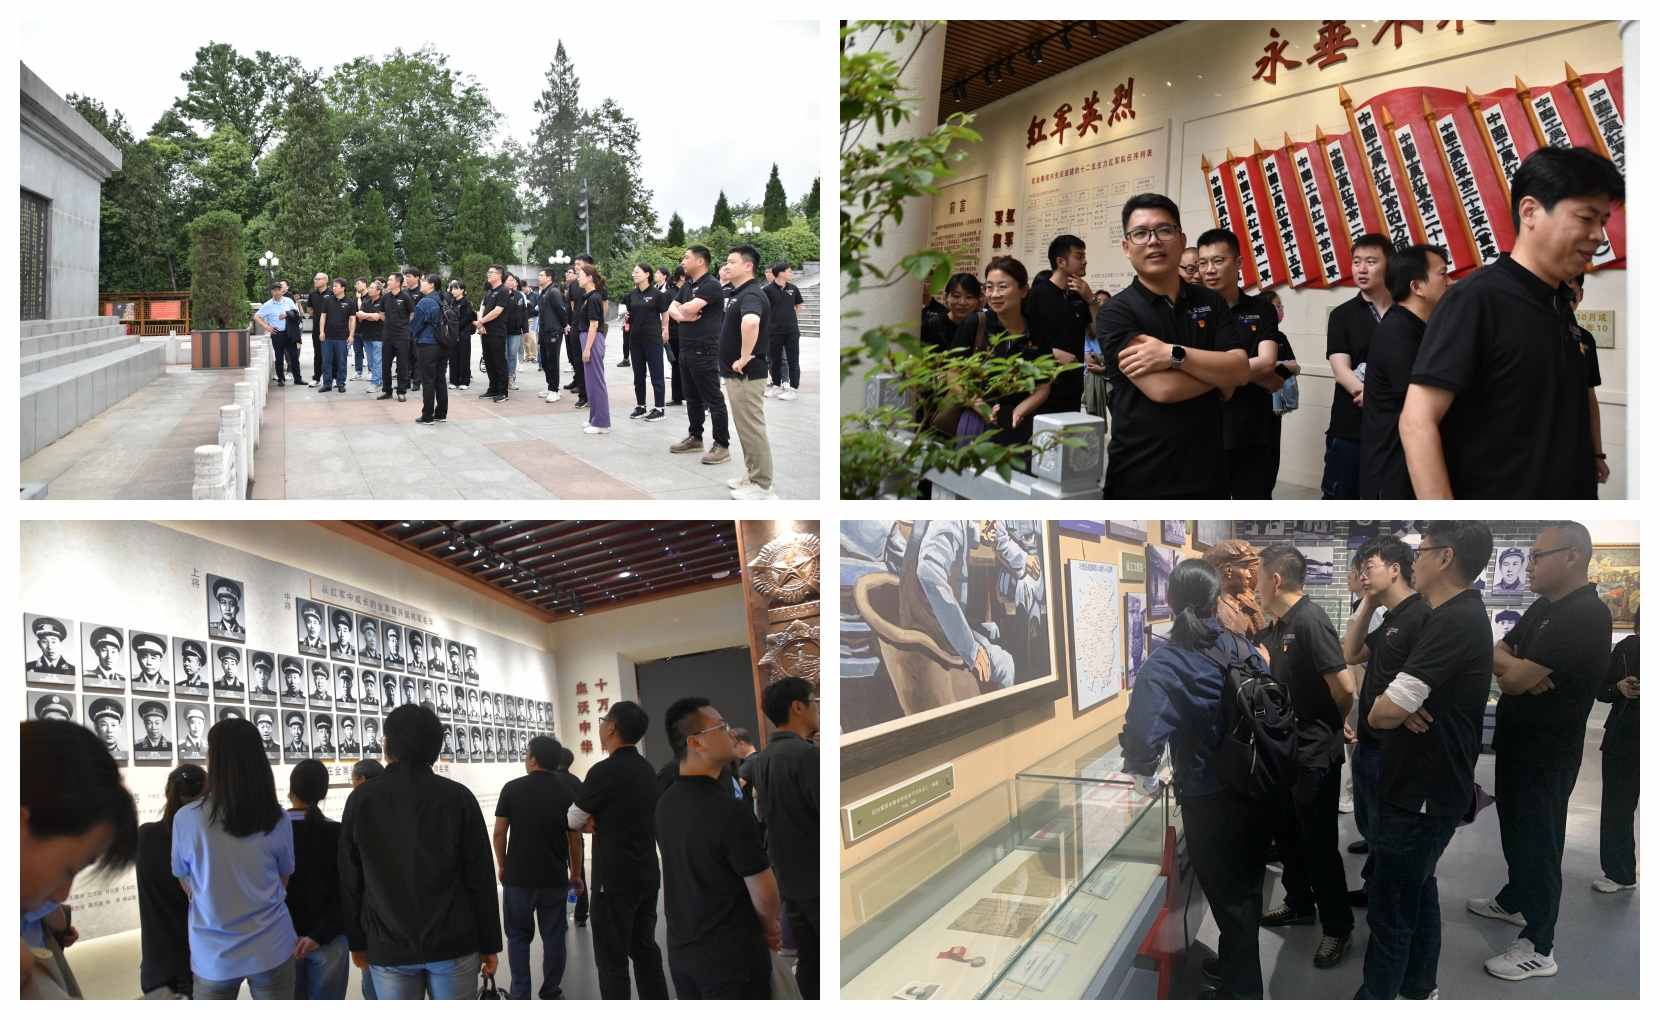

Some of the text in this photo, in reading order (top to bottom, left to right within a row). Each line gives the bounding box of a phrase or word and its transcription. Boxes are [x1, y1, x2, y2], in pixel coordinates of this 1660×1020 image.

[1252, 20, 1497, 83] 永垂不
[1026, 77, 1136, 150] 红军英烈
[949, 199, 966, 215] 前言
[1210, 175, 1231, 232] 中國工農紅
[1003, 208, 1016, 260] 红军
[190, 567, 200, 589] 上将
[284, 592, 292, 611] 中将
[321, 583, 434, 627] 从红军中成长的金寨籍开国将军名录
[576, 680, 594, 755] 血沃中华
